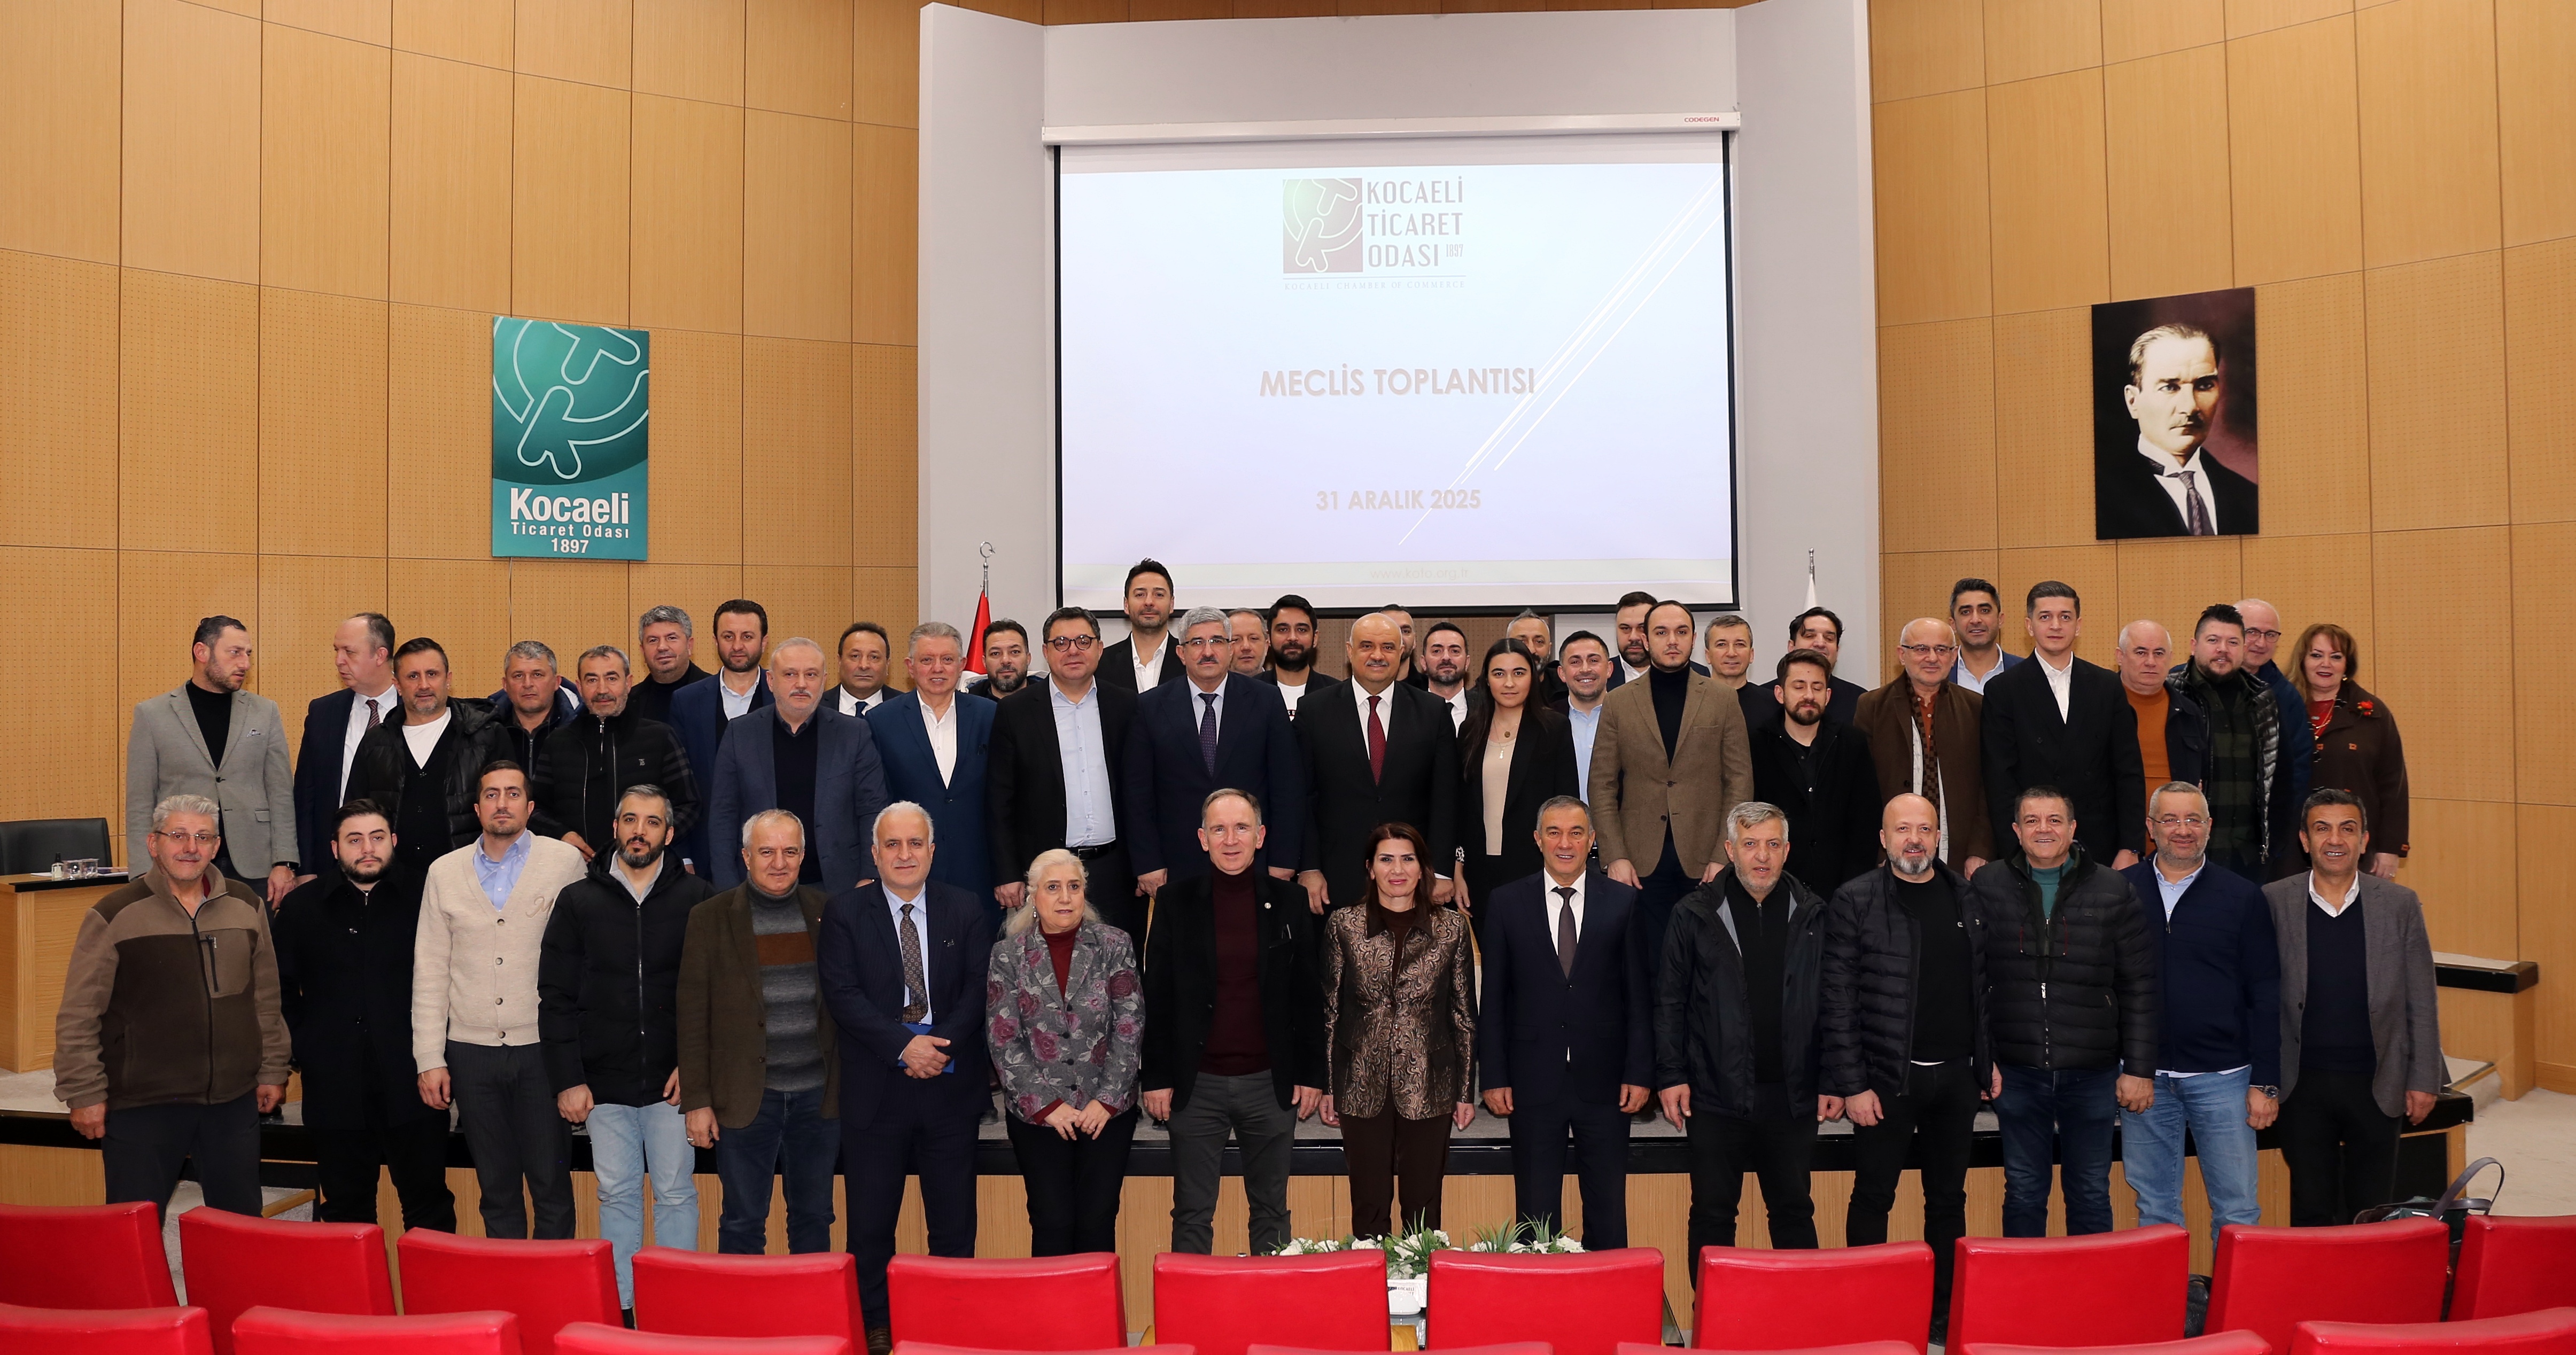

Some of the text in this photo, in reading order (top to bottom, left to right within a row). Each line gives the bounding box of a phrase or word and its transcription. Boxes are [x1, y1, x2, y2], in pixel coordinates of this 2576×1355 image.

[1367, 176, 1463, 204] KOCAELİ
[1367, 209, 1463, 236] TİCARET
[1368, 244, 1464, 268] ODASI 1897
[1407, 281, 1465, 289] COMMERCE
[1259, 363, 1535, 397] MECLİS TOPLANTISI
[510, 487, 629, 525] Kocaeli
[1316, 489, 1481, 511] 31 ARALIK 2025
[511, 521, 629, 539] Ticaret Odası
[551, 538, 589, 554] 1897
[1370, 567, 1469, 581] www.koto.org.tr
